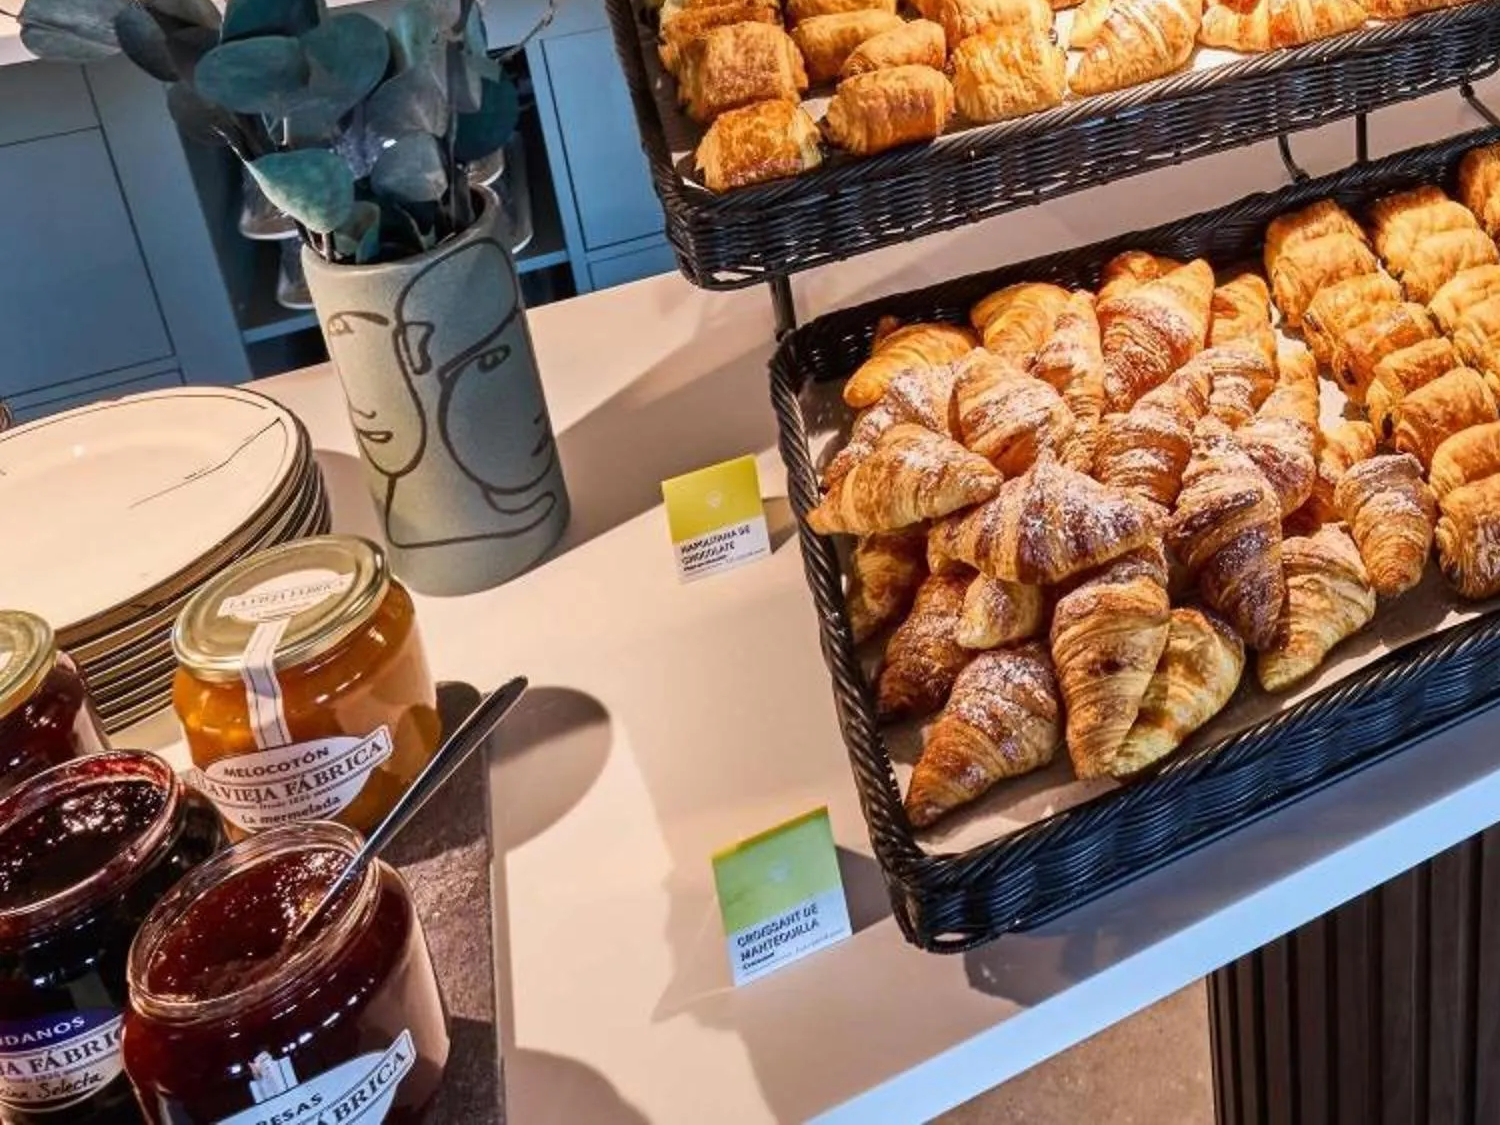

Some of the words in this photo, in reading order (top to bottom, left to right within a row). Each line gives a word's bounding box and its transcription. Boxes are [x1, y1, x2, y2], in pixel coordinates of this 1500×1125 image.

[220, 786, 277, 804] VIEJA
[285, 741, 383, 797] FÁBRICA
[223, 746, 329, 778] MELOCOTÓN
[260, 796, 340, 823] mermelada
